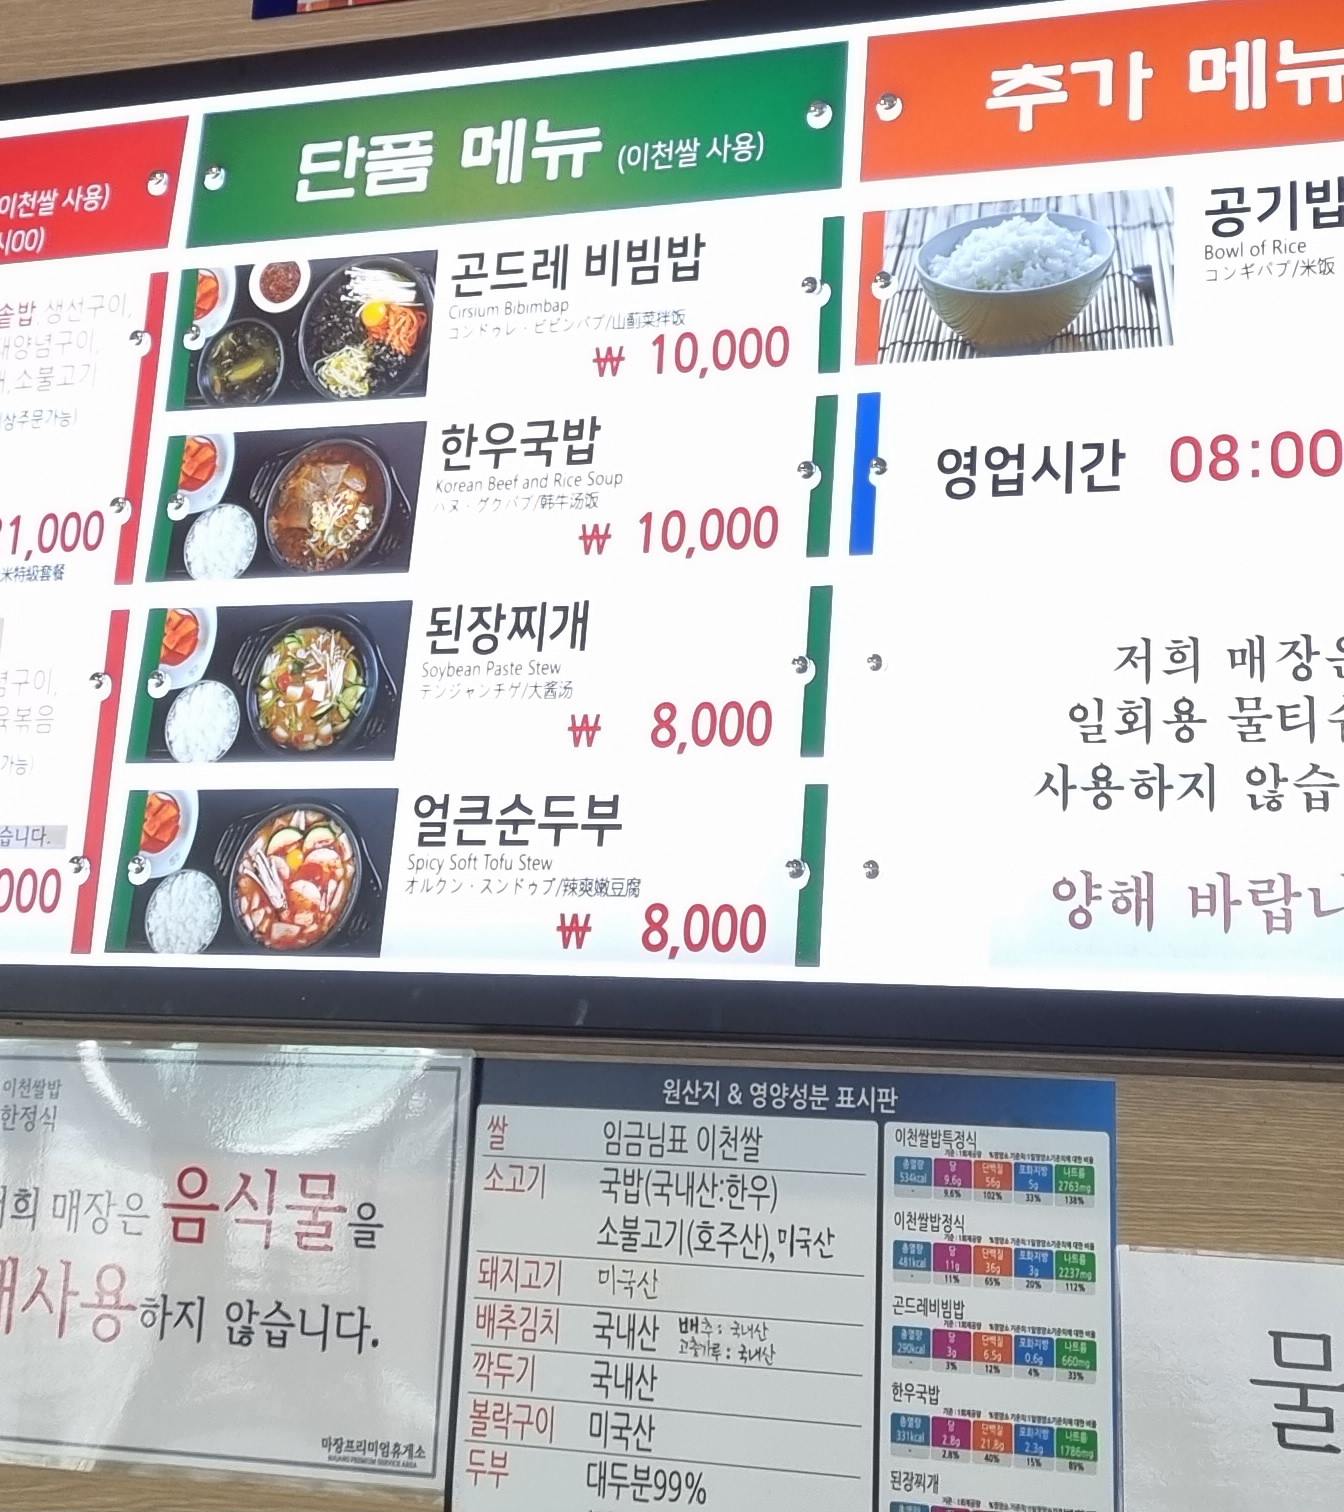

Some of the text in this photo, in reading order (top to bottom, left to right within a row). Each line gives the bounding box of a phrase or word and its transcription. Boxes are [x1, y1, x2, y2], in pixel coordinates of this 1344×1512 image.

[984, 49, 1154, 133] 추가
[295, 129, 434, 203] 단품
[461, 118, 603, 186] 메뉴
[706, 131, 765, 166] 사용)
[61, 182, 110, 214] 사용)
[451, 232, 707, 297] 곤드레 비빔밥
[1205, 239, 1307, 260] Bowl of Rice
[449, 299, 569, 320] Cirsium Bibimbap
[651, 326, 790, 380] 10,000
[441, 416, 602, 473] 한우국밥
[936, 437, 1126, 502] 영업시간
[1170, 427, 1344, 484] 08:00
[436, 471, 623, 494] Korean Beef and Rice Soup
[638, 506, 778, 559] 10,000
[425, 600, 590, 655] 된장찌개
[422, 660, 561, 681] Soybean Paste Stew
[1112, 635, 1202, 686] 저희
[651, 699, 773, 755] 8,000
[1067, 694, 1208, 747] 일회용
[1034, 763, 1219, 814] 사용하지
[413, 793, 624, 848] 얼큰순두부
[407, 854, 553, 875] Spicy Soft Tofu Stew
[1051, 869, 1157, 934] 양해
[641, 902, 768, 960] 8,000
[3, 1078, 63, 1100] 이천쌀밥
[663, 1079, 898, 1115] 원산지 영양성분 표시판
[0, 1104, 57, 1133] 한정식
[487, 1115, 764, 1163] 쌀 임금님표 이천쌀
[895, 1128, 977, 1150] 이천쌀밥특정식
[52, 1190, 151, 1236] 매장은
[162, 1165, 385, 1252] 음식물을
[483, 1163, 778, 1215] 소고기 국밥(국내산:한우)
[894, 1211, 965, 1234] 이천쌀밥정식
[477, 1255, 658, 1300] 돼지고기 미국산
[225, 1299, 380, 1354] 않습니다.
[476, 1303, 660, 1353] 배추김치 국내산
[892, 1295, 965, 1319] 곤드레비빔밥
[472, 1350, 657, 1402] 깍두기 국내산
[891, 1381, 941, 1405] 한우국밥
[321, 1436, 427, 1460] 마장프리미엄휴게소
[469, 1399, 656, 1452] 볼락구이 미국산
[466, 1449, 707, 1506] 두부 대두분99%
